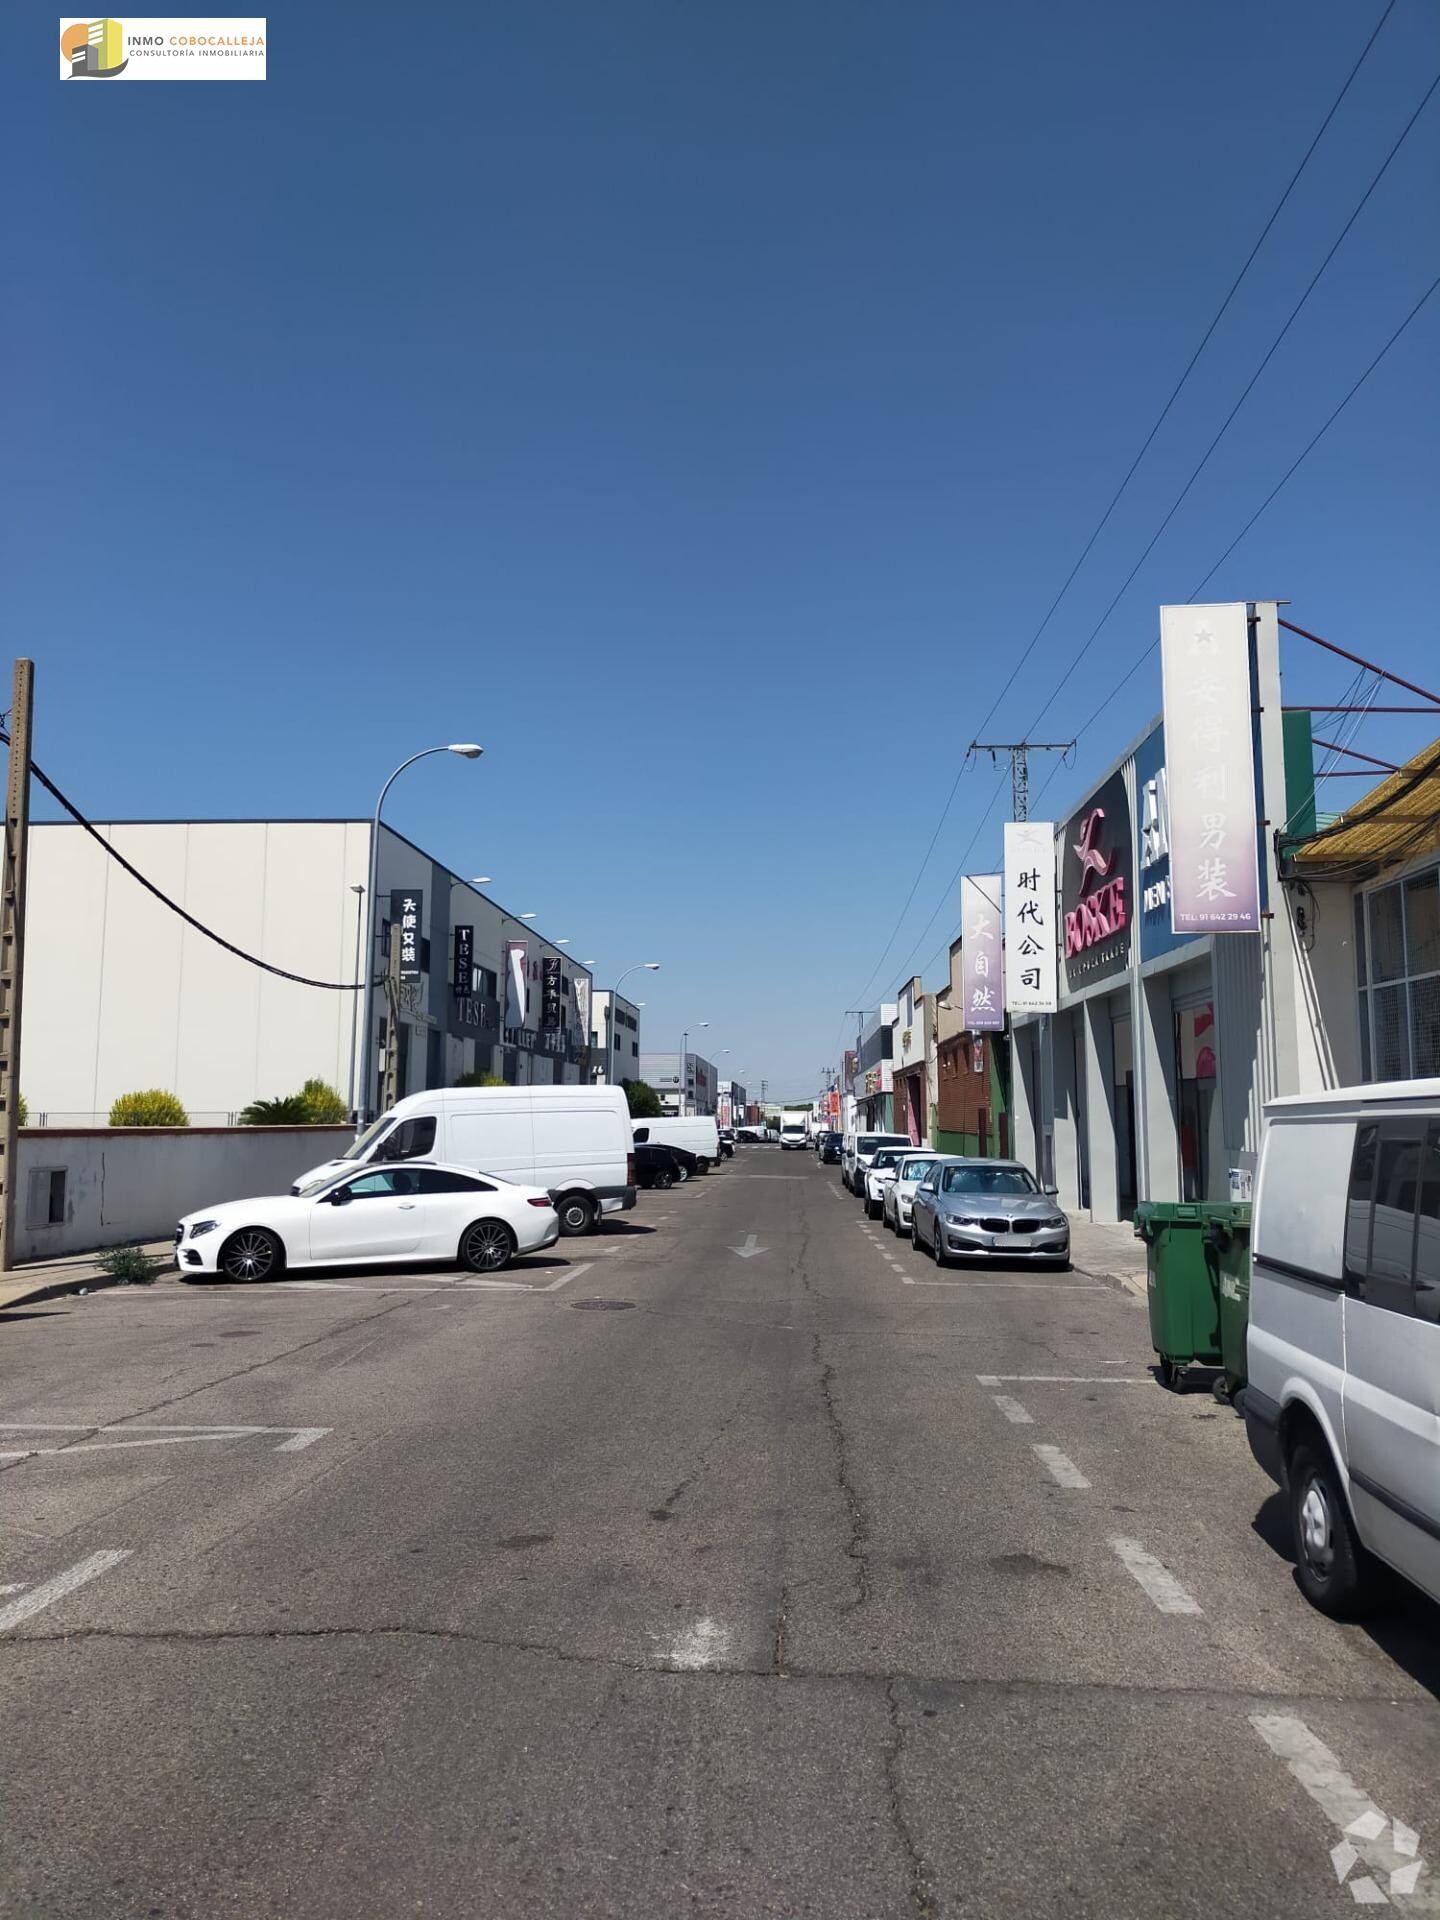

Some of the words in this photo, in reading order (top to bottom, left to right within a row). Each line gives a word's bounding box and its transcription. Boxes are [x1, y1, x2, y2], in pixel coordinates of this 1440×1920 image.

[402, 898, 417, 962] 天使女装
[1017, 867, 1044, 990] 时代公司
[1065, 876, 1126, 959] BOSKE
[1209, 913, 1226, 921] 642
[459, 929, 470, 984] TESE
[970, 914, 996, 1012] 大自然
